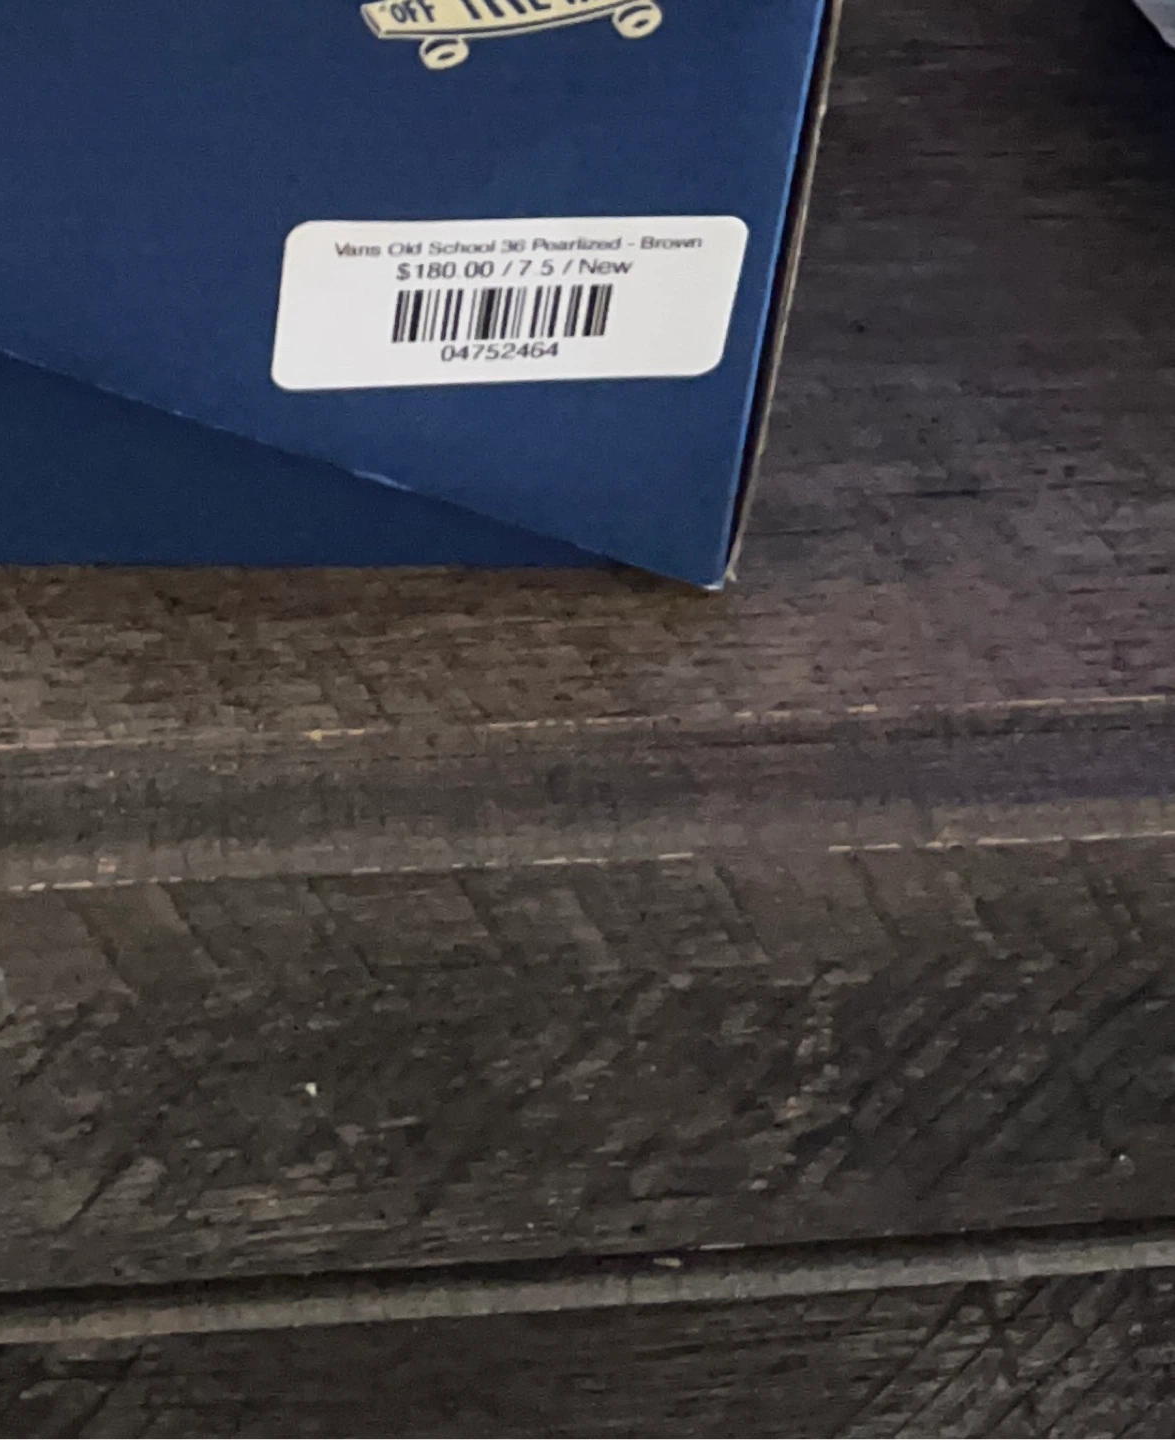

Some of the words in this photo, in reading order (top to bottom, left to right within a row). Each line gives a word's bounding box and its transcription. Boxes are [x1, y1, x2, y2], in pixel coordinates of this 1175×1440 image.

[334, 241, 382, 258] Vans
[388, 241, 422, 257] Old
[429, 239, 495, 255] School
[502, 238, 527, 254] 36
[532, 236, 621, 253] Pearlized
[640, 235, 703, 251] Brown
[396, 261, 494, 281] $180.00
[578, 257, 634, 275] New
[439, 342, 560, 363] 04752464
